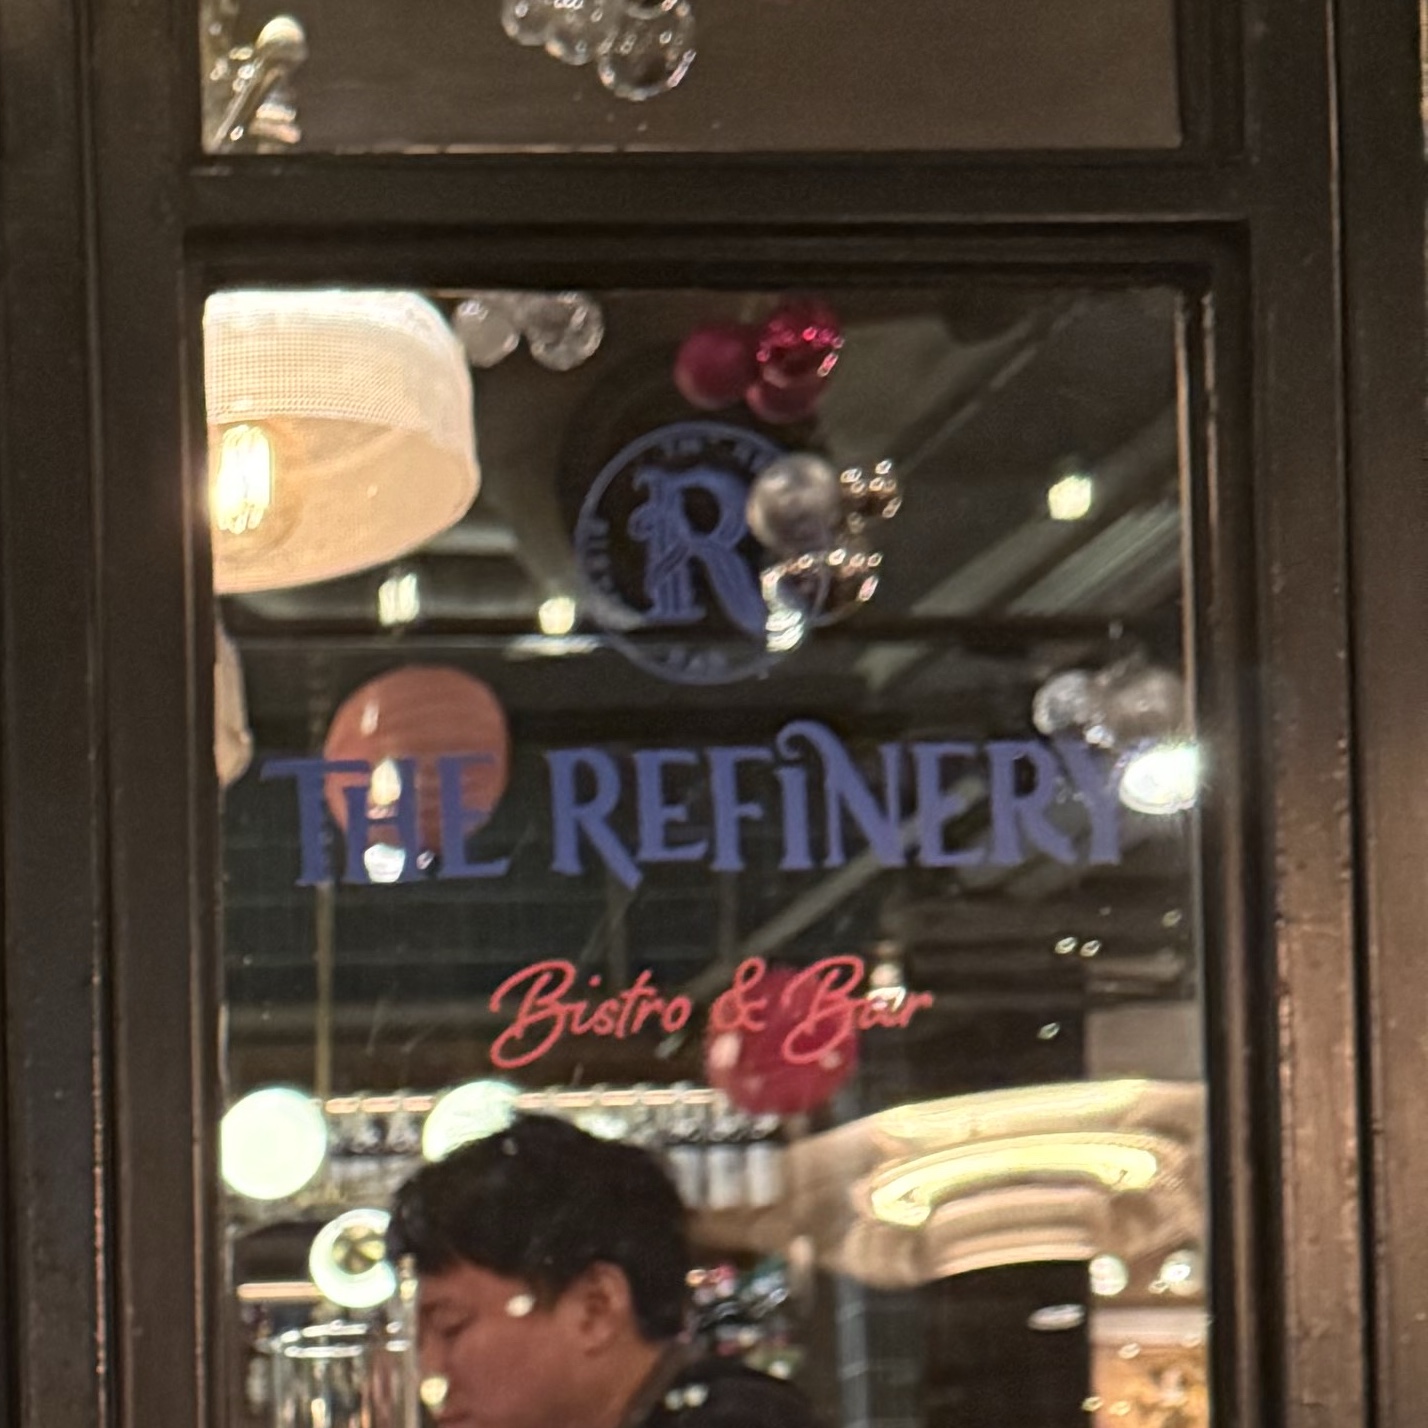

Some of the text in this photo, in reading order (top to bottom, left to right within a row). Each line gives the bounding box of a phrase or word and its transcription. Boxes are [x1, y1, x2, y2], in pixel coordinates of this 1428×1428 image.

[260, 754, 511, 886] THE
[489, 955, 933, 1068] Bistro & Bar
